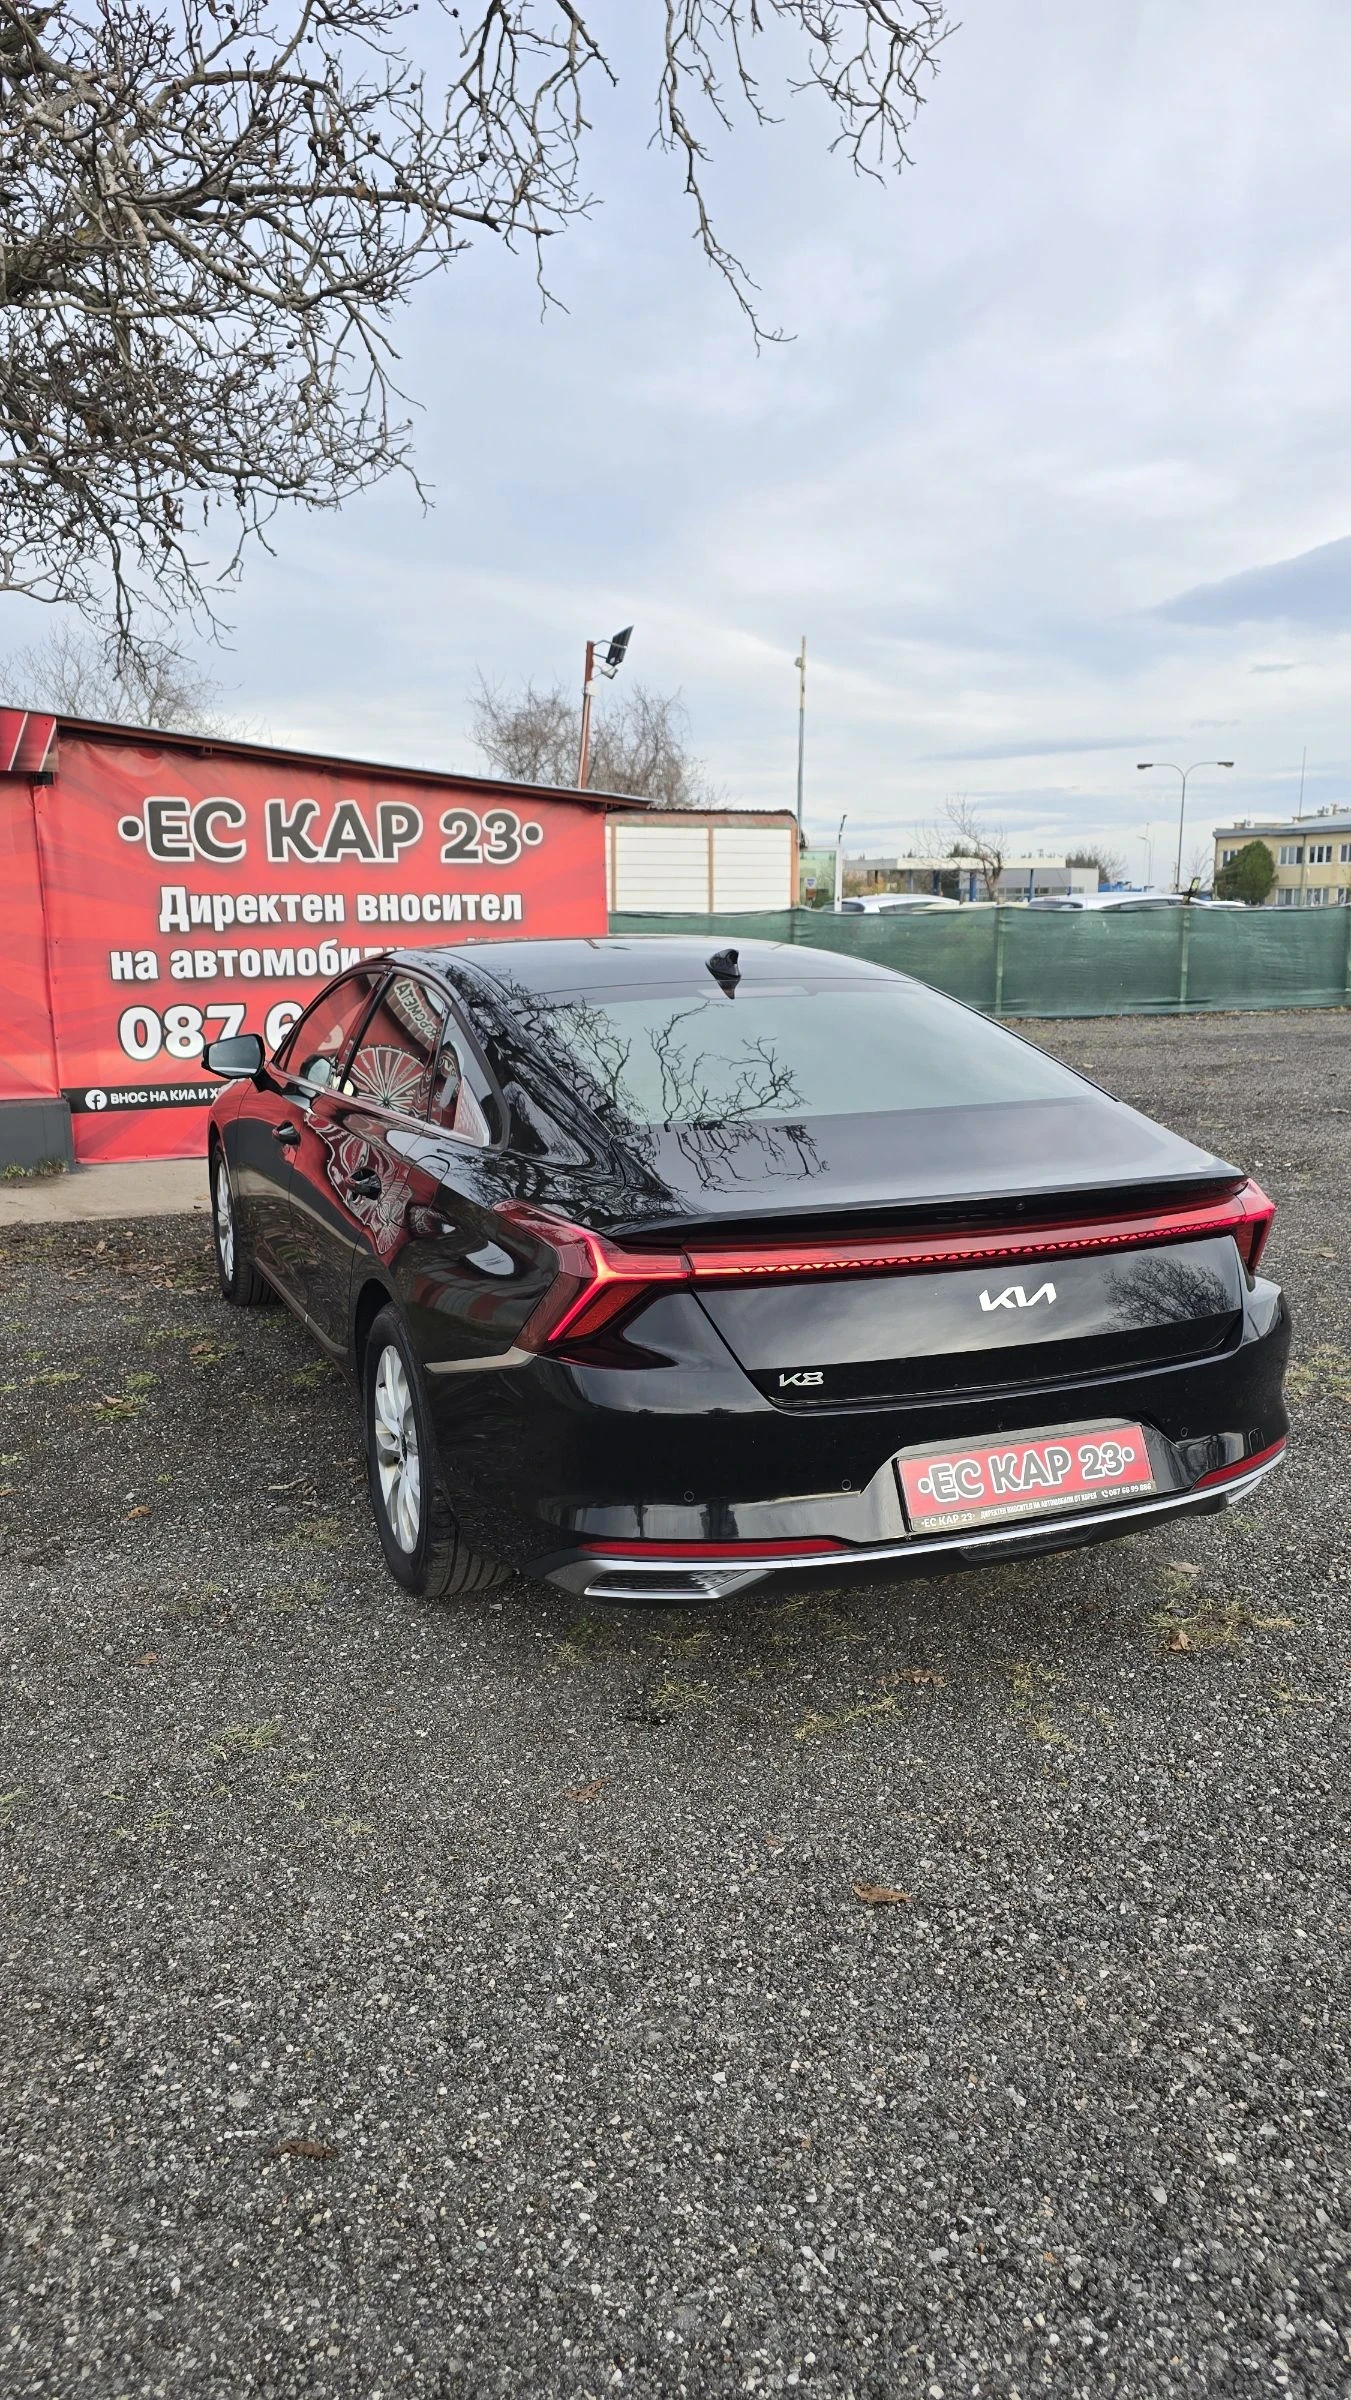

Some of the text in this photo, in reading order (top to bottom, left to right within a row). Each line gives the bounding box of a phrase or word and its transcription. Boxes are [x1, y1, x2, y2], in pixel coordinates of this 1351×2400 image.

[265, 798, 423, 863] КАР
[158, 886, 523, 932] Директен вносител
[110, 939, 405, 981] на автомоби
[118, 1003, 246, 1061] 087
[110, 1091, 148, 1105] ВНОС
[150, 1090, 168, 1103] НА
[170, 1088, 197, 1101] КИА
[198, 1088, 208, 1100] И
[779, 1371, 824, 1387] K8
[988, 1447, 1072, 1493] КАР
[1108, 1487, 1121, 1497] 087
[939, 1514, 959, 1525] КАР
